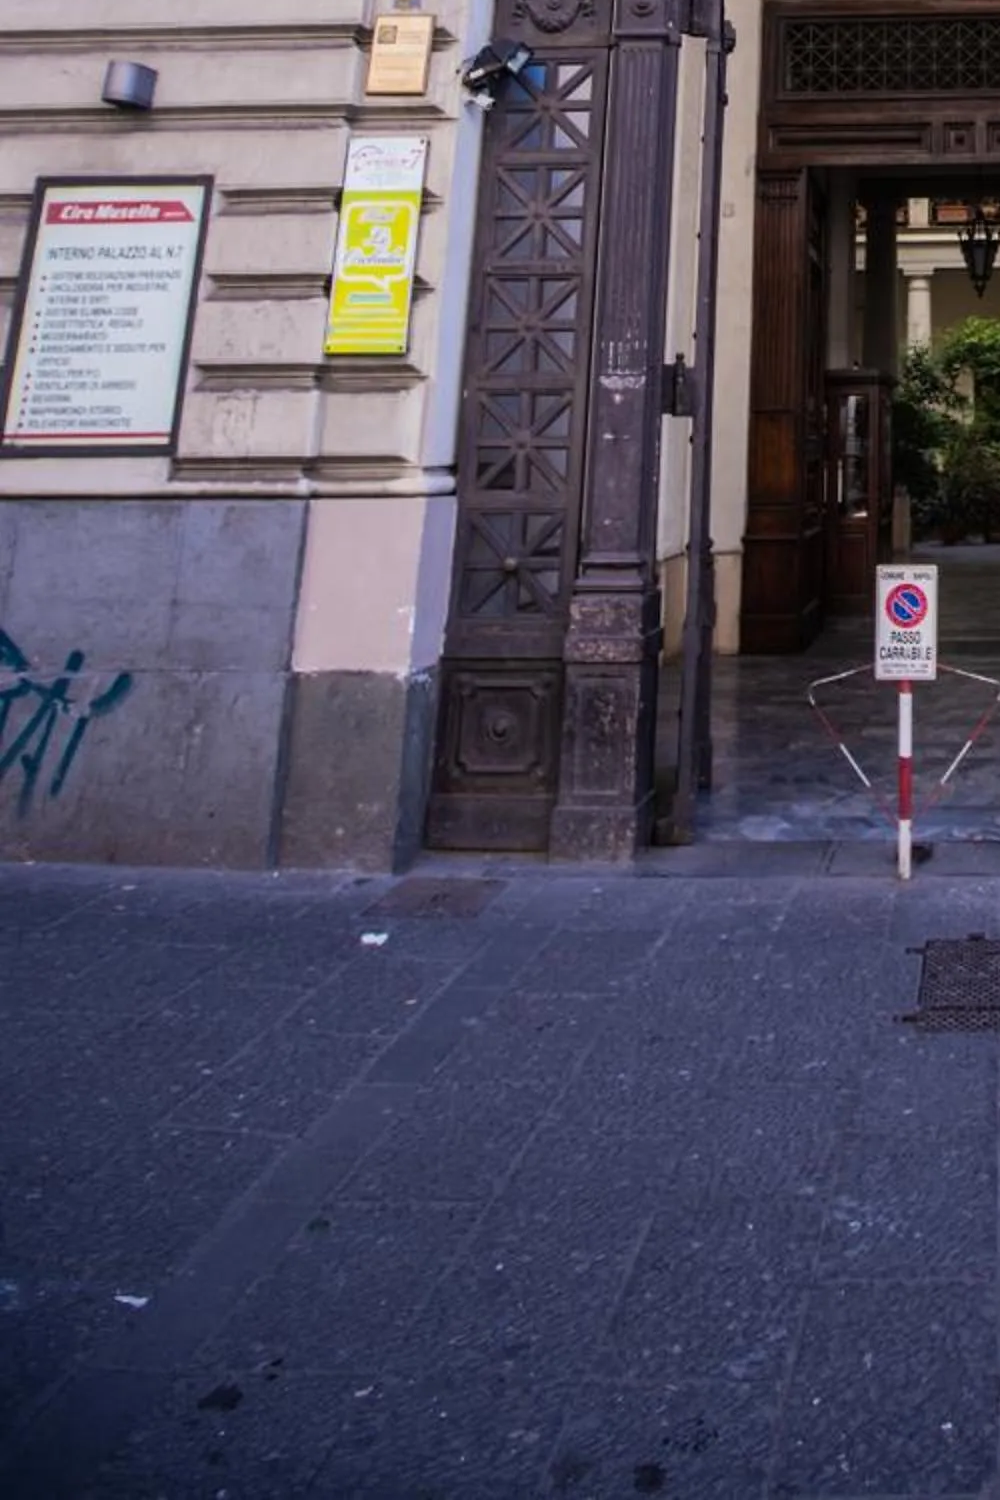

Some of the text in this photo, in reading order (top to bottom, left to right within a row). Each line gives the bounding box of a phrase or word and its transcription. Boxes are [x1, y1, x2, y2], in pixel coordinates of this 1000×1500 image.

[47, 247, 95, 261] INTERNO
[97, 246, 147, 260] PALAZZO
[890, 631, 922, 645] PASSO
